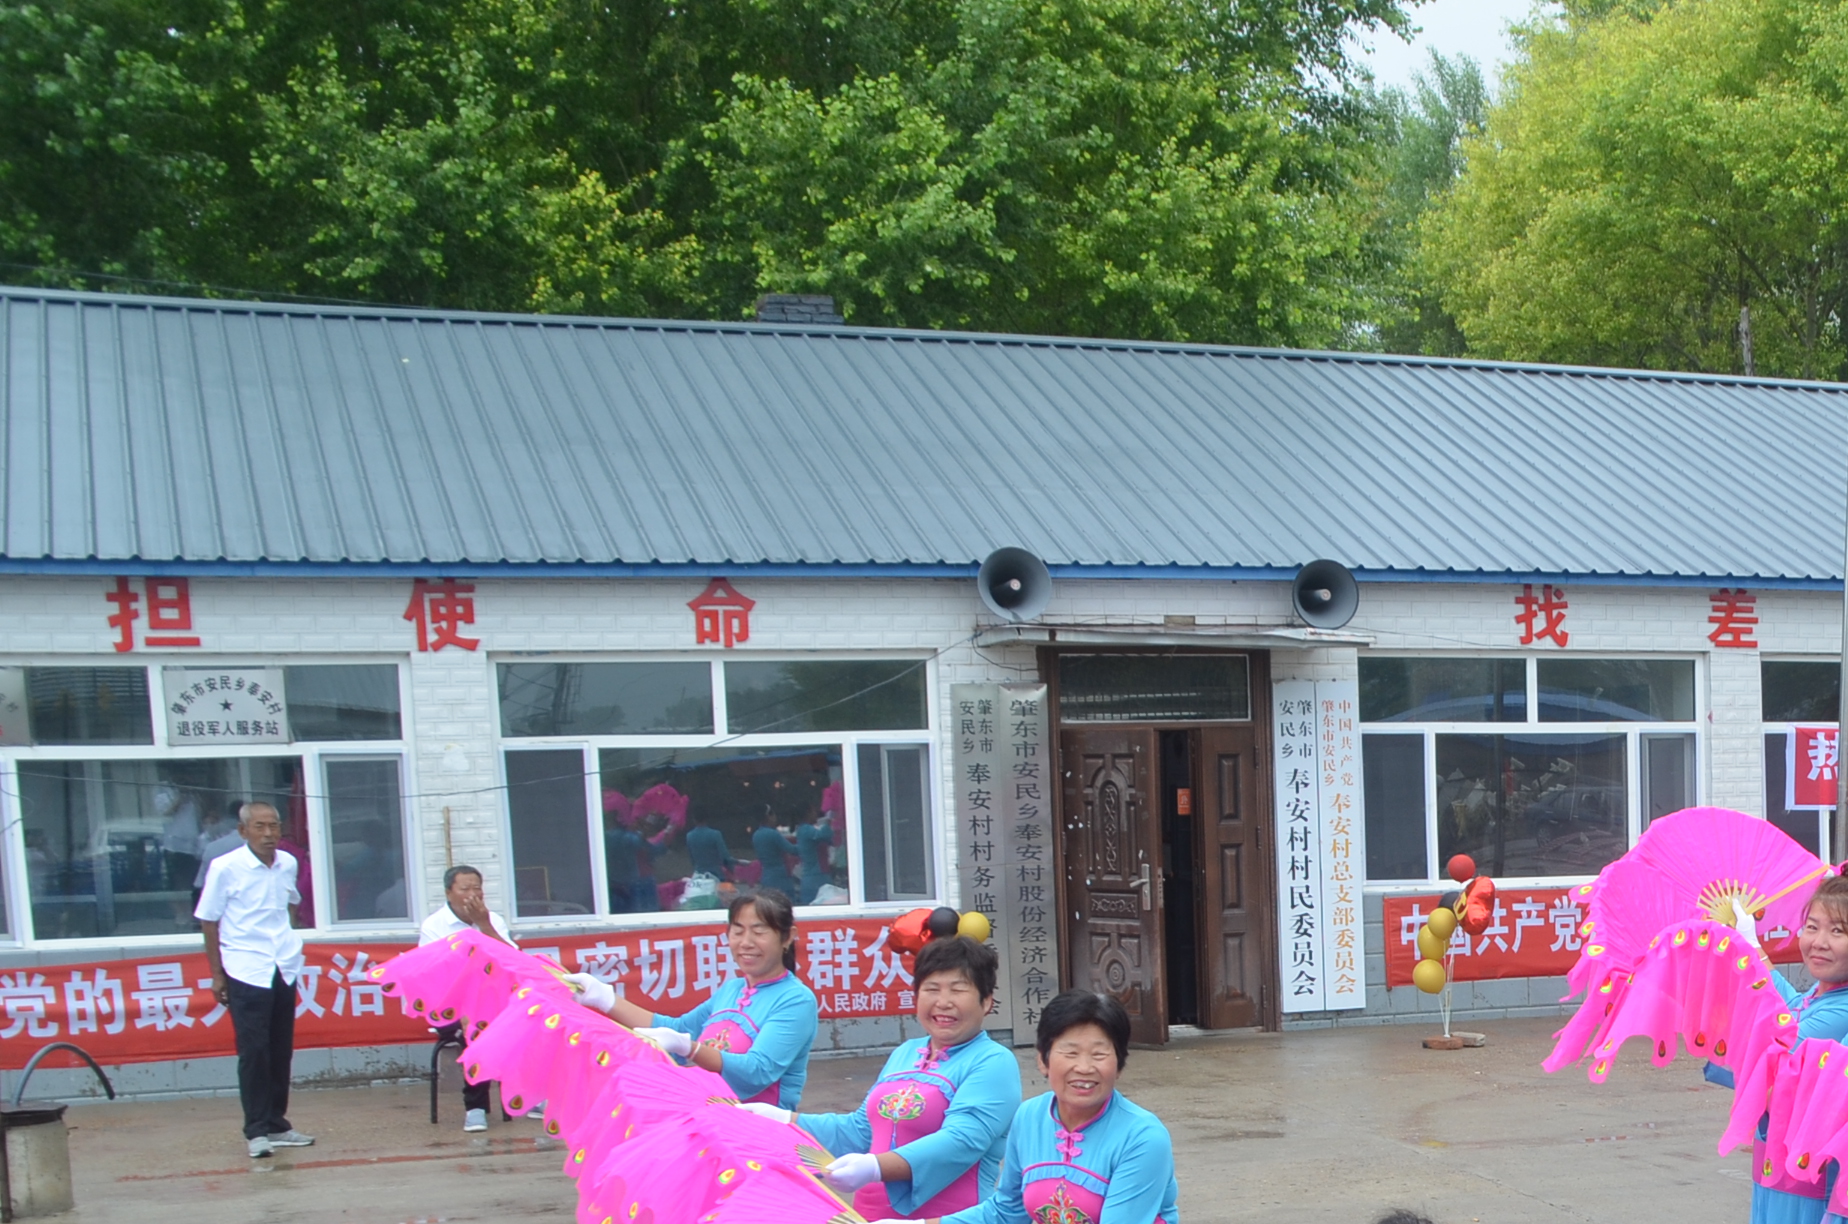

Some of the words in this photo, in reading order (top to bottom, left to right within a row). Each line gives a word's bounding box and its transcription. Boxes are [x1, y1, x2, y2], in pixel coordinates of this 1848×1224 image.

[177, 720, 279, 737] 退役军人服务站
[959, 700, 976, 755] 安民乡
[1279, 700, 1296, 759] 安民乡
[1338, 700, 1354, 786] 中国共产党
[966, 763, 1002, 1015] 奉安村村务监
[1285, 768, 1317, 996] 奉安村村民委员会
[1329, 793, 1356, 994] 奉安村总支部委员会
